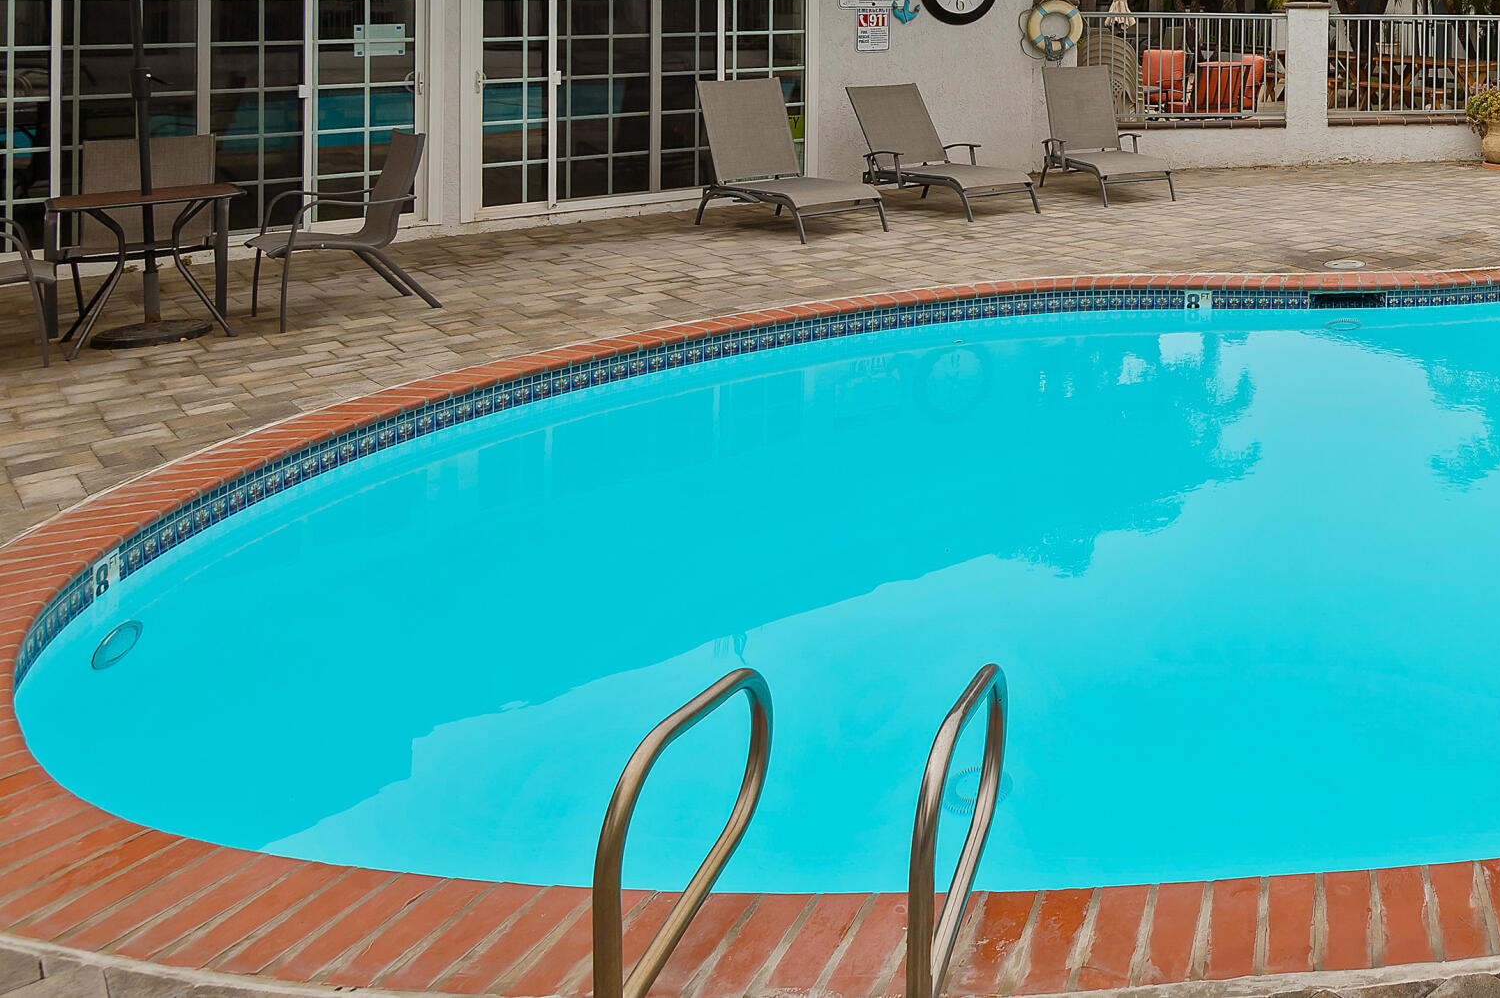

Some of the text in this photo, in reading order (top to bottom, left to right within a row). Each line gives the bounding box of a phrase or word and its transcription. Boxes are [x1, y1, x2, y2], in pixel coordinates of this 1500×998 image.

[869, 14, 888, 27] 911
[1187, 292, 1210, 309] 8 FT
[95, 563, 109, 598] 8
